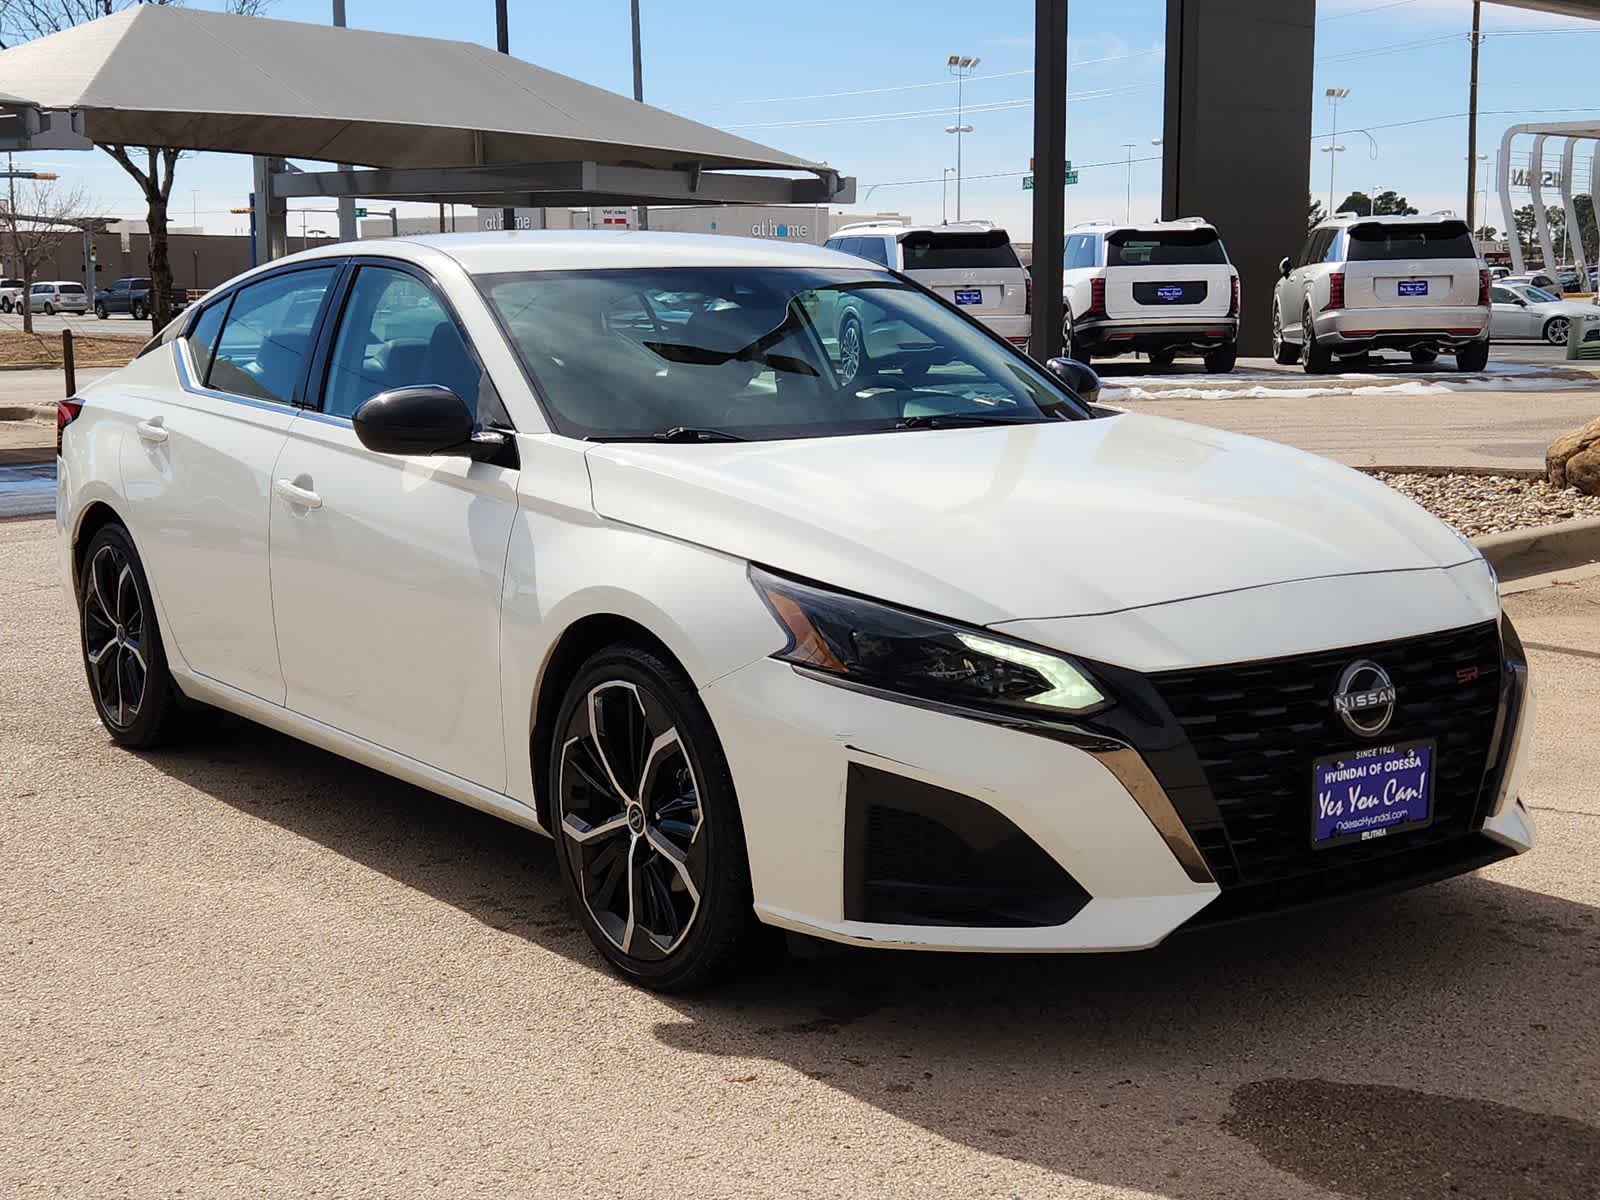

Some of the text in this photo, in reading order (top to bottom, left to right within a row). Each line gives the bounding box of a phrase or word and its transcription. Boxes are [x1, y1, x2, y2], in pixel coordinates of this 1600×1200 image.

[1456, 667, 1478, 683] SR
[1335, 688, 1396, 710] NISSAN
[1355, 748, 1377, 760] SINCE
[1325, 756, 1422, 784] HYUNDAI OF ODESSA
[1319, 771, 1426, 819] Yes You Can!
